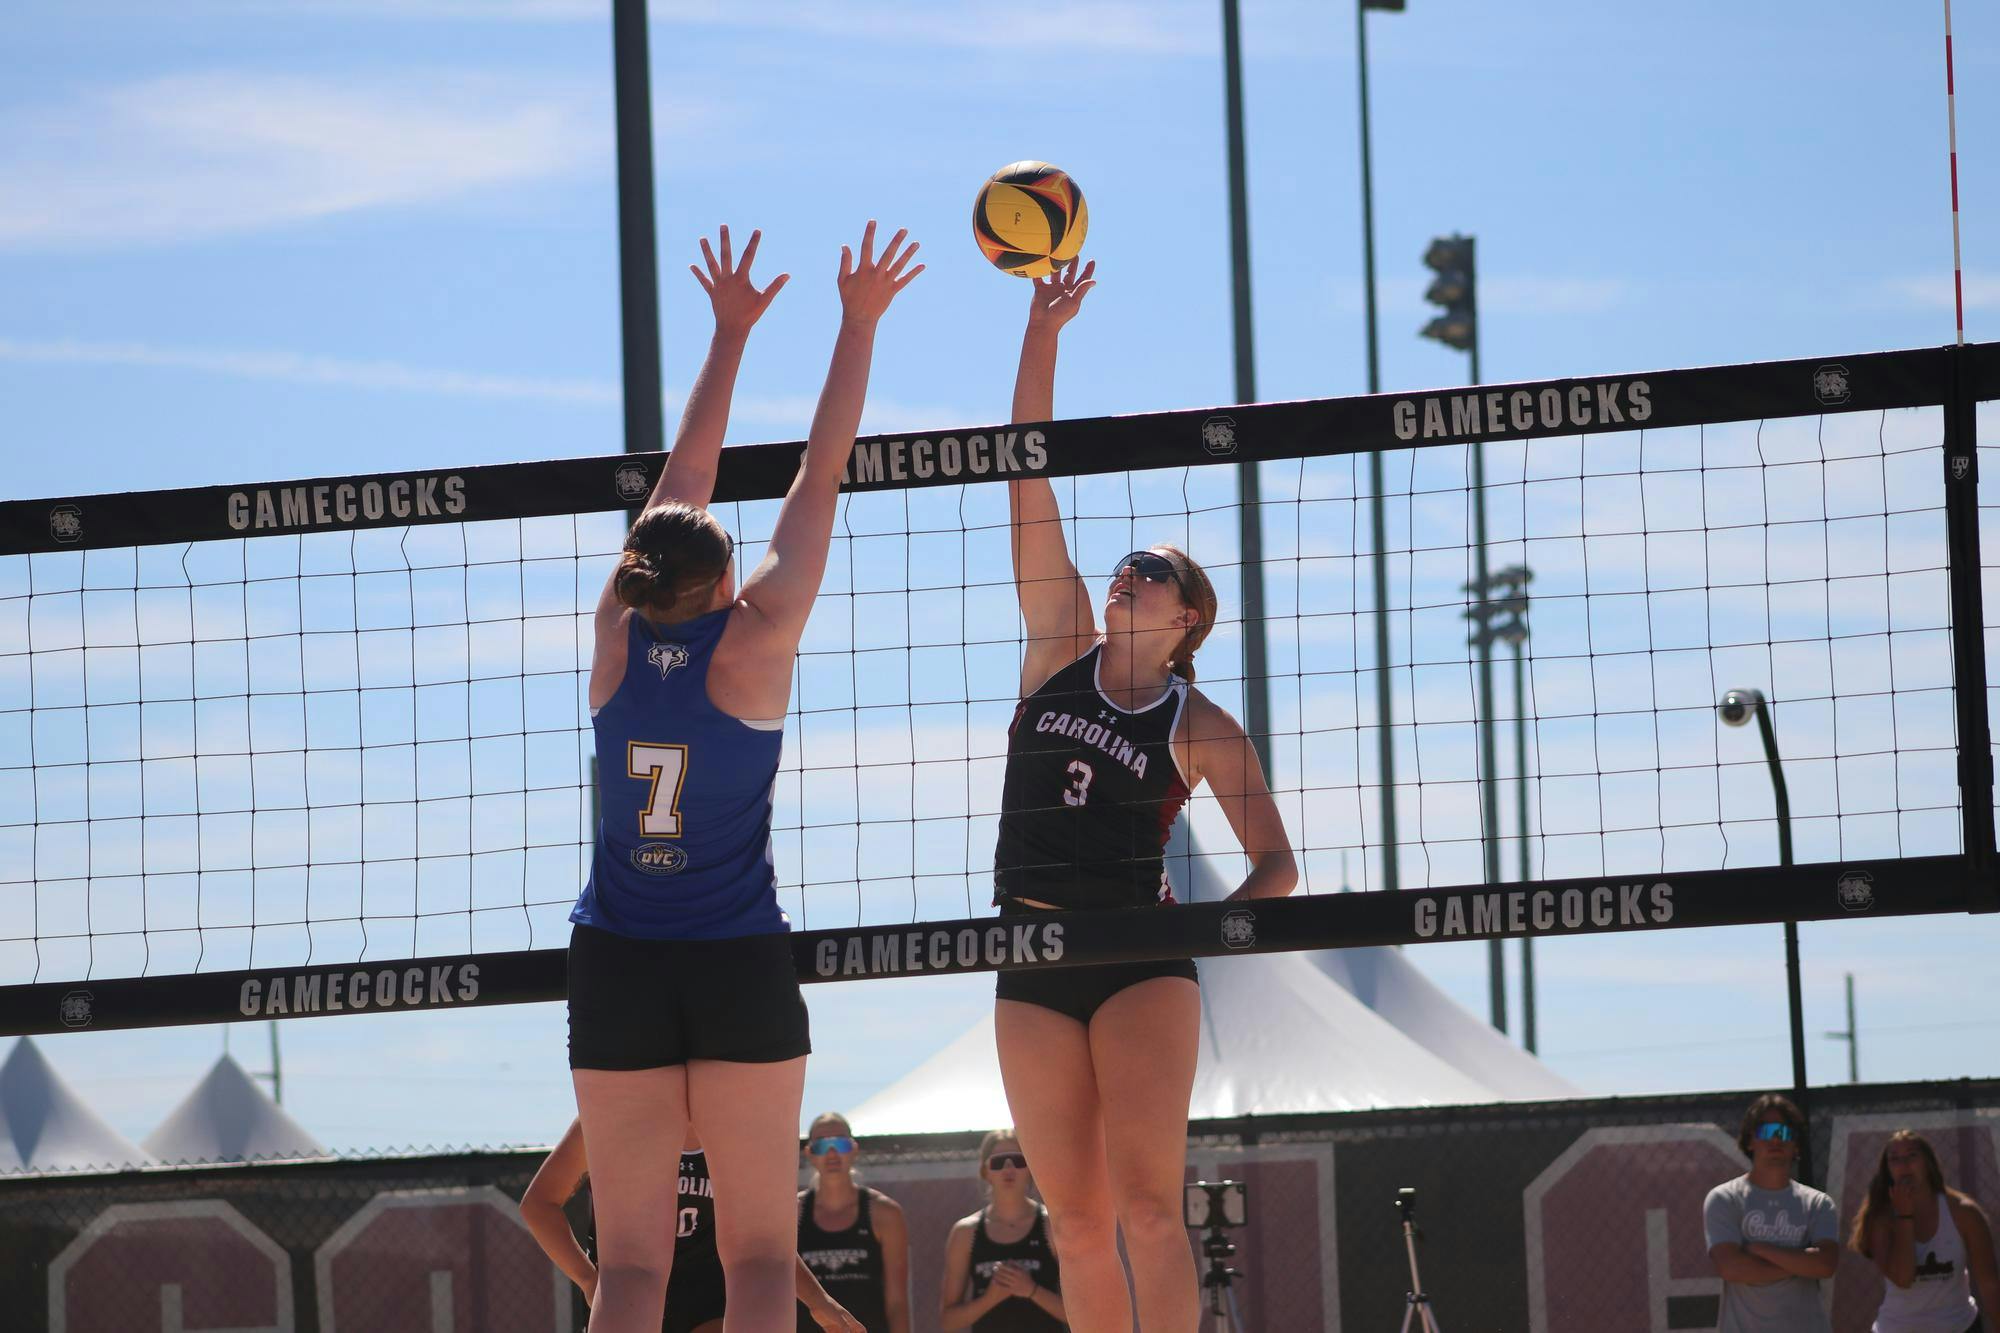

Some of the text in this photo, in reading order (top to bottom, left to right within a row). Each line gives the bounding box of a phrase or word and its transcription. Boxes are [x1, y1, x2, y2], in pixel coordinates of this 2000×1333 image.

[1393, 381, 1652, 441] GAMECOCKS
[801, 430, 1048, 484] MECOCKS
[227, 475, 467, 531] GAMECOCKS
[1035, 711, 1149, 780] CAROLINA
[628, 741, 688, 838] 7
[1062, 759, 1094, 807] 3
[642, 852, 674, 865] OVC
[1414, 883, 1675, 938] GAMECOCKS
[815, 922, 1065, 976] GAMECOCKS
[239, 963, 480, 1016] GAMECOCKS
